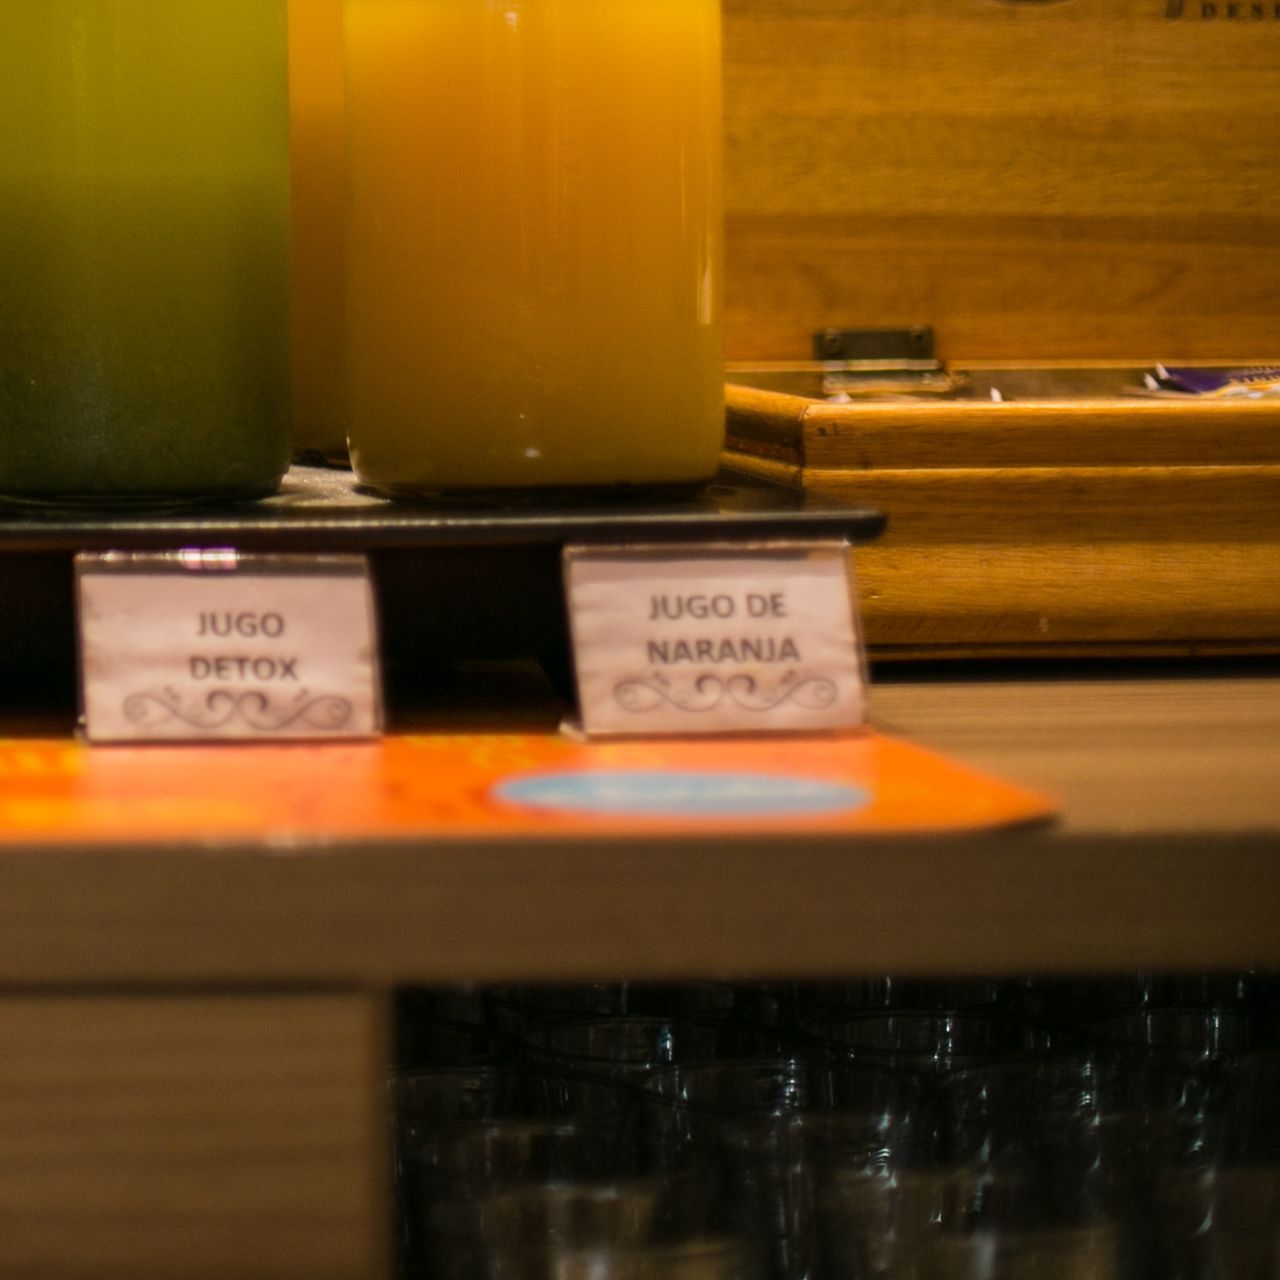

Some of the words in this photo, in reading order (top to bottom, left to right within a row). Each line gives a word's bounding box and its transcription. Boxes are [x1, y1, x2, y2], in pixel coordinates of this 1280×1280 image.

[649, 594, 736, 620] JUGO
[746, 593, 789, 618] DE
[196, 611, 285, 638] JUGO
[647, 637, 801, 664] NARANJA
[190, 656, 299, 682] DETOX
